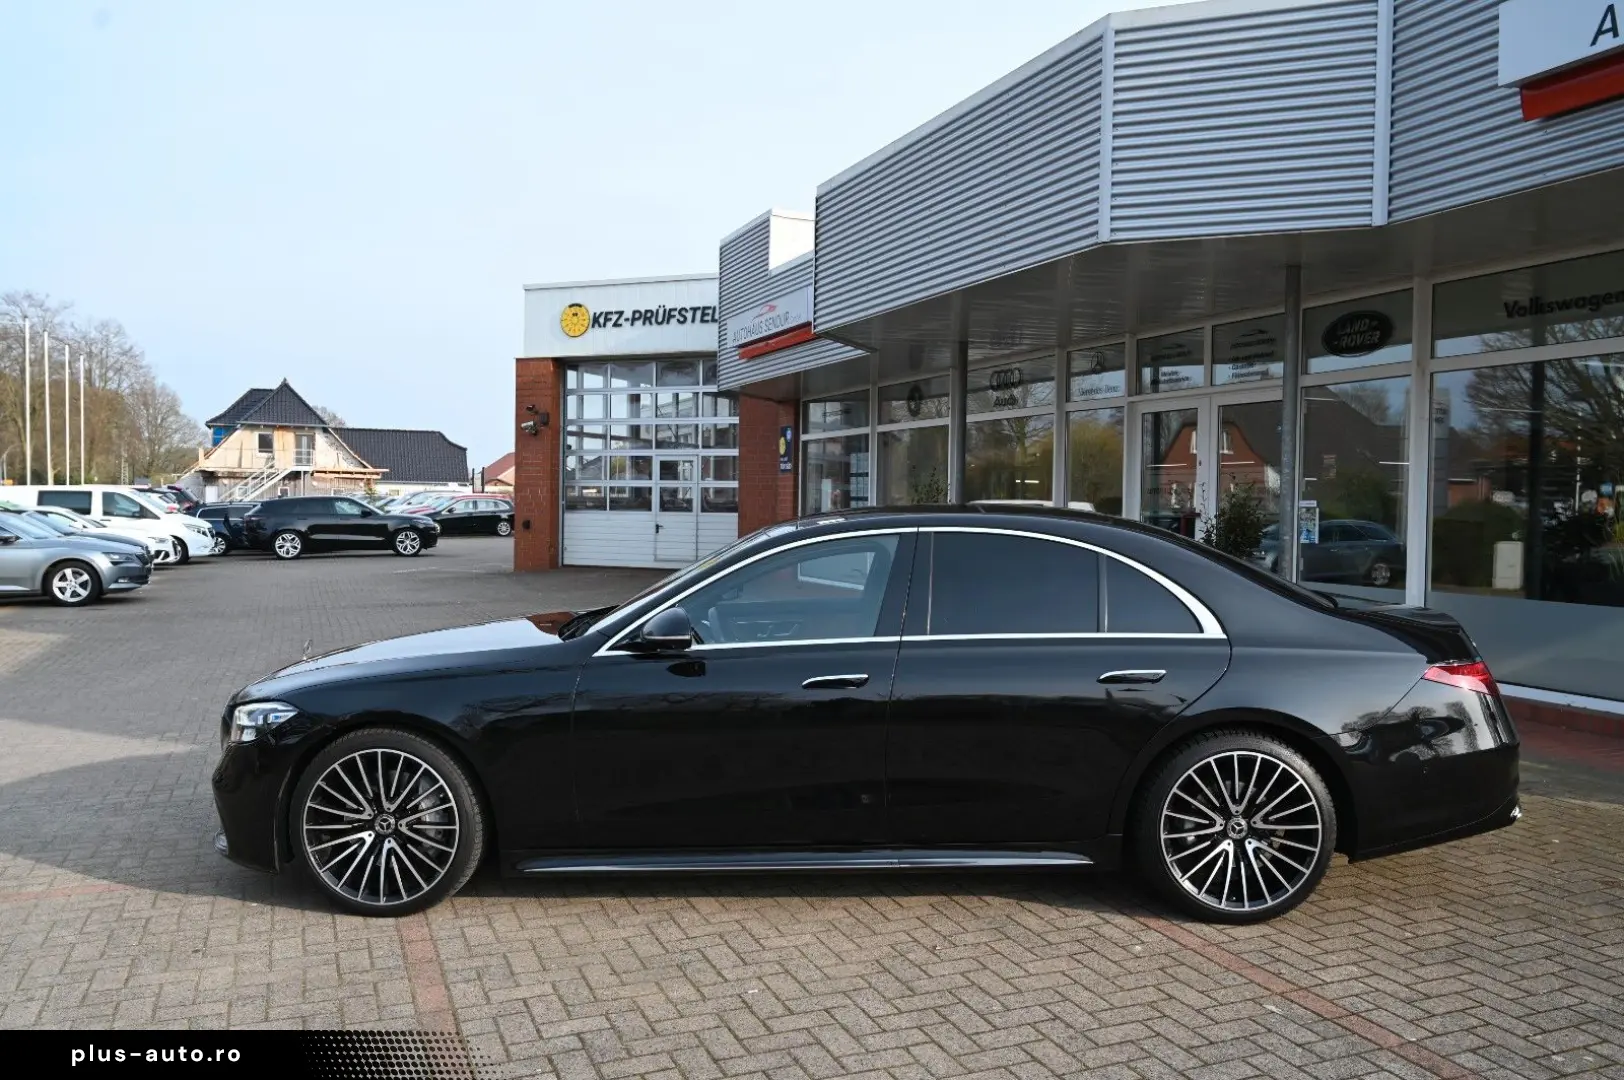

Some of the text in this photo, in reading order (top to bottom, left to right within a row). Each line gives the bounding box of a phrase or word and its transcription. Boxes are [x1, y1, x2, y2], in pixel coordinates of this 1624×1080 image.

[1590, 3, 1620, 47] A
[591, 304, 719, 329] KFZ-PRÜFSTEL
[1503, 289, 1624, 319] Volkswagen
[732, 319, 763, 343] AUTOHAUS
